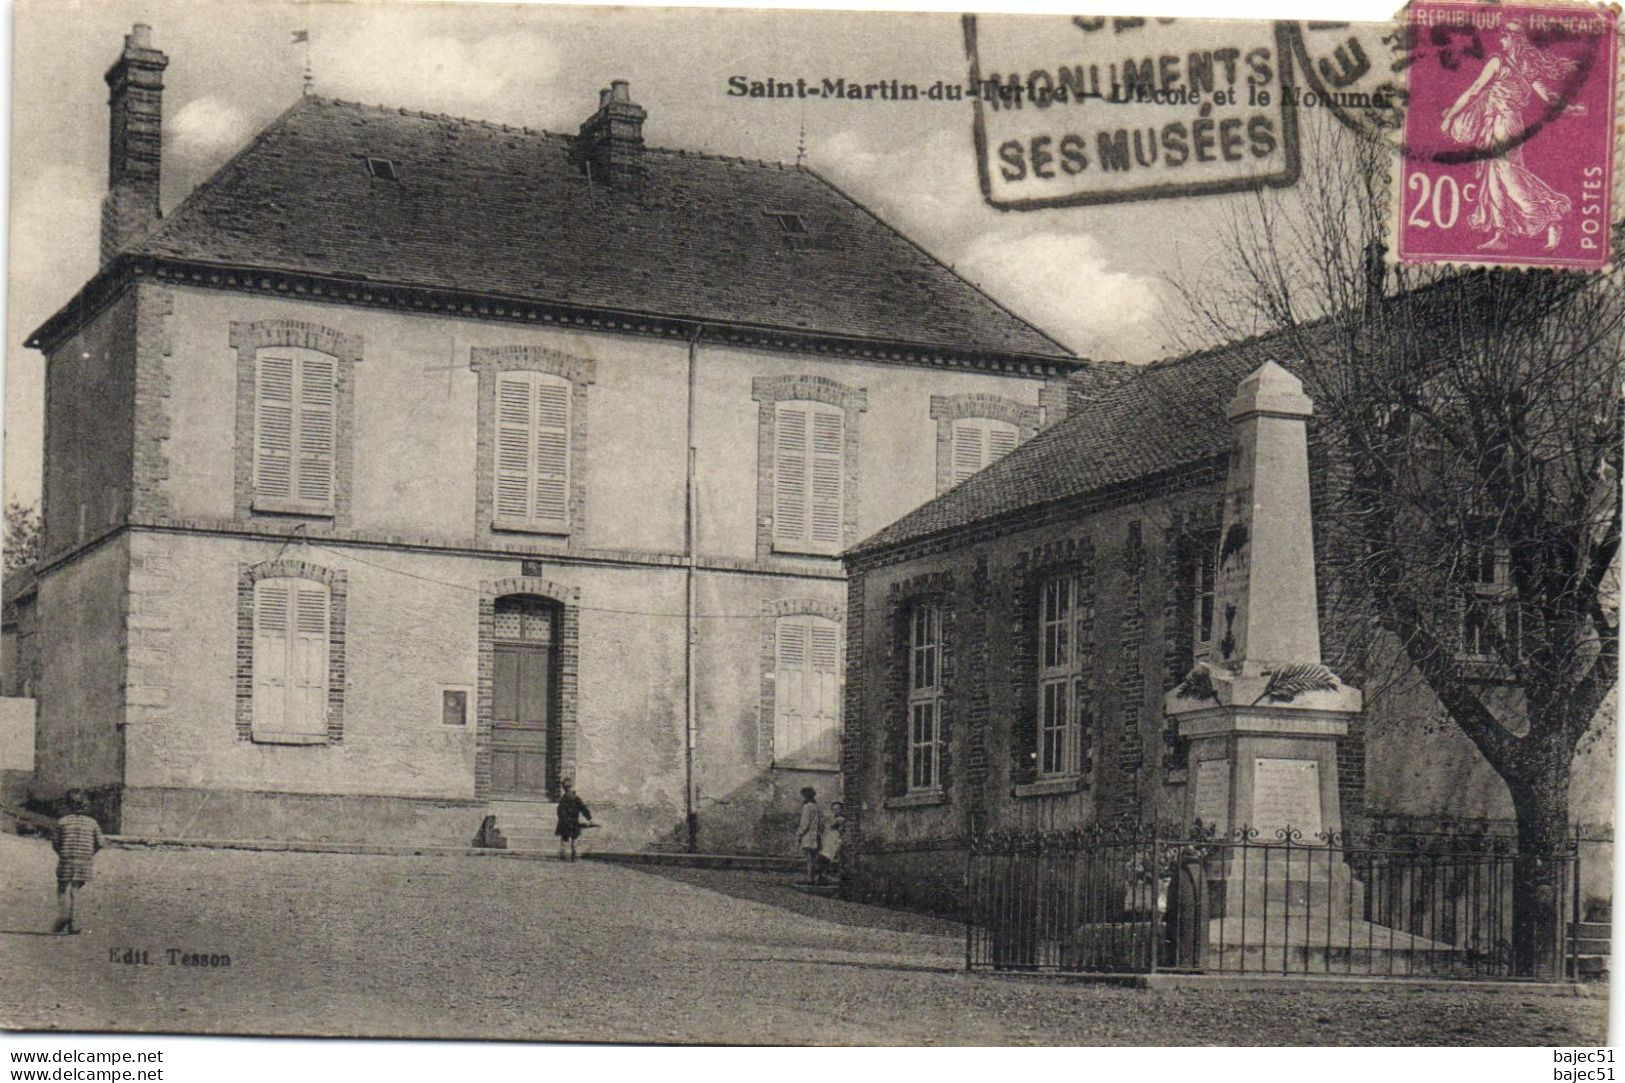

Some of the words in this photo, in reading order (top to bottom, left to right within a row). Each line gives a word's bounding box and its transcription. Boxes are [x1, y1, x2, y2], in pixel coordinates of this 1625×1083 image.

[989, 47, 1273, 112] MONUMENTS
[1213, 87, 1237, 106] et
[1248, 84, 1271, 106] le
[999, 134, 1088, 182] SES
[1097, 103, 1278, 172] MUSÉES
[1580, 165, 1603, 250] POSTES
[166, 948, 232, 967] Tesson
